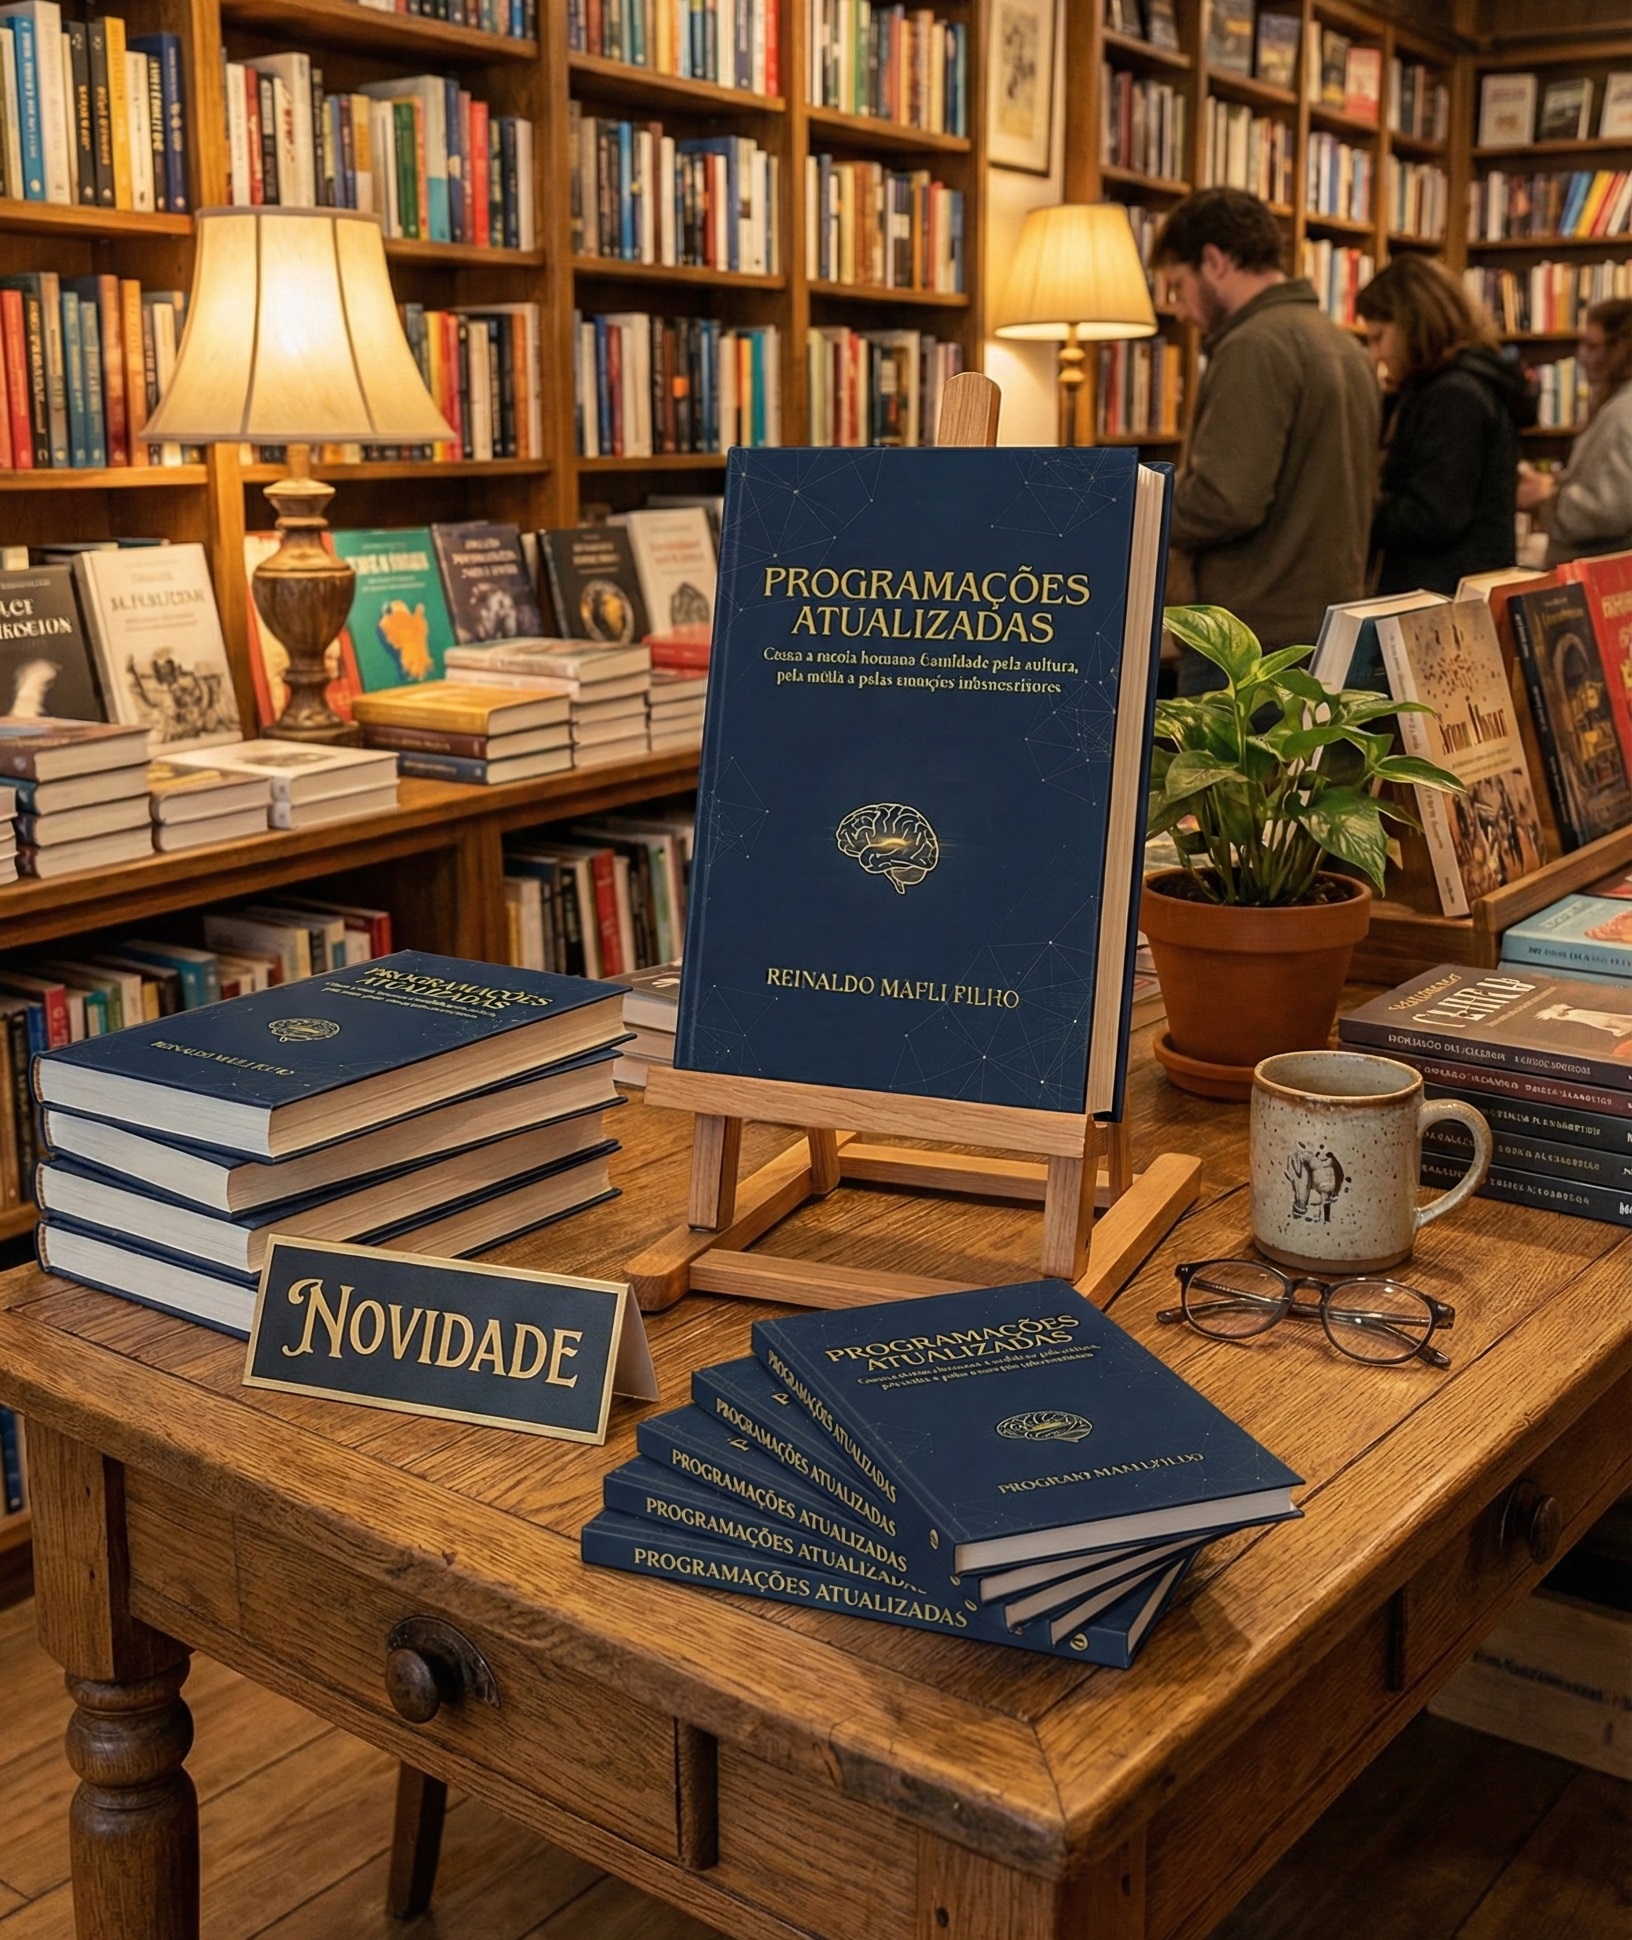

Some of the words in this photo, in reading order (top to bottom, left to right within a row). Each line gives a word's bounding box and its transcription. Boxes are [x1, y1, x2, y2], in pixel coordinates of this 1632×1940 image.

[763, 566, 1092, 610] PROGRAMAÇÕES
[791, 605, 1055, 643] ATUALIZADAS
[777, 668, 804, 685] pela
[992, 656, 1021, 674] pela
[767, 967, 875, 995] REINALDO
[281, 1278, 584, 1389] NOVIDADE
[825, 1314, 1080, 1363] PROGRAMAÇÕES
[866, 1330, 1074, 1372] ATUALIZADAS
[671, 1448, 796, 1521] PROGRAMAÇÕES
[798, 1509, 908, 1574] ATUALIZADAS
[810, 1463, 897, 1537] ATUALIZADAS
[645, 1498, 794, 1557] PROGRAMAÇÕES
[633, 1547, 811, 1597] PROGRAMAÇÕES
[815, 1582, 969, 1630] ATUALIZADAS
